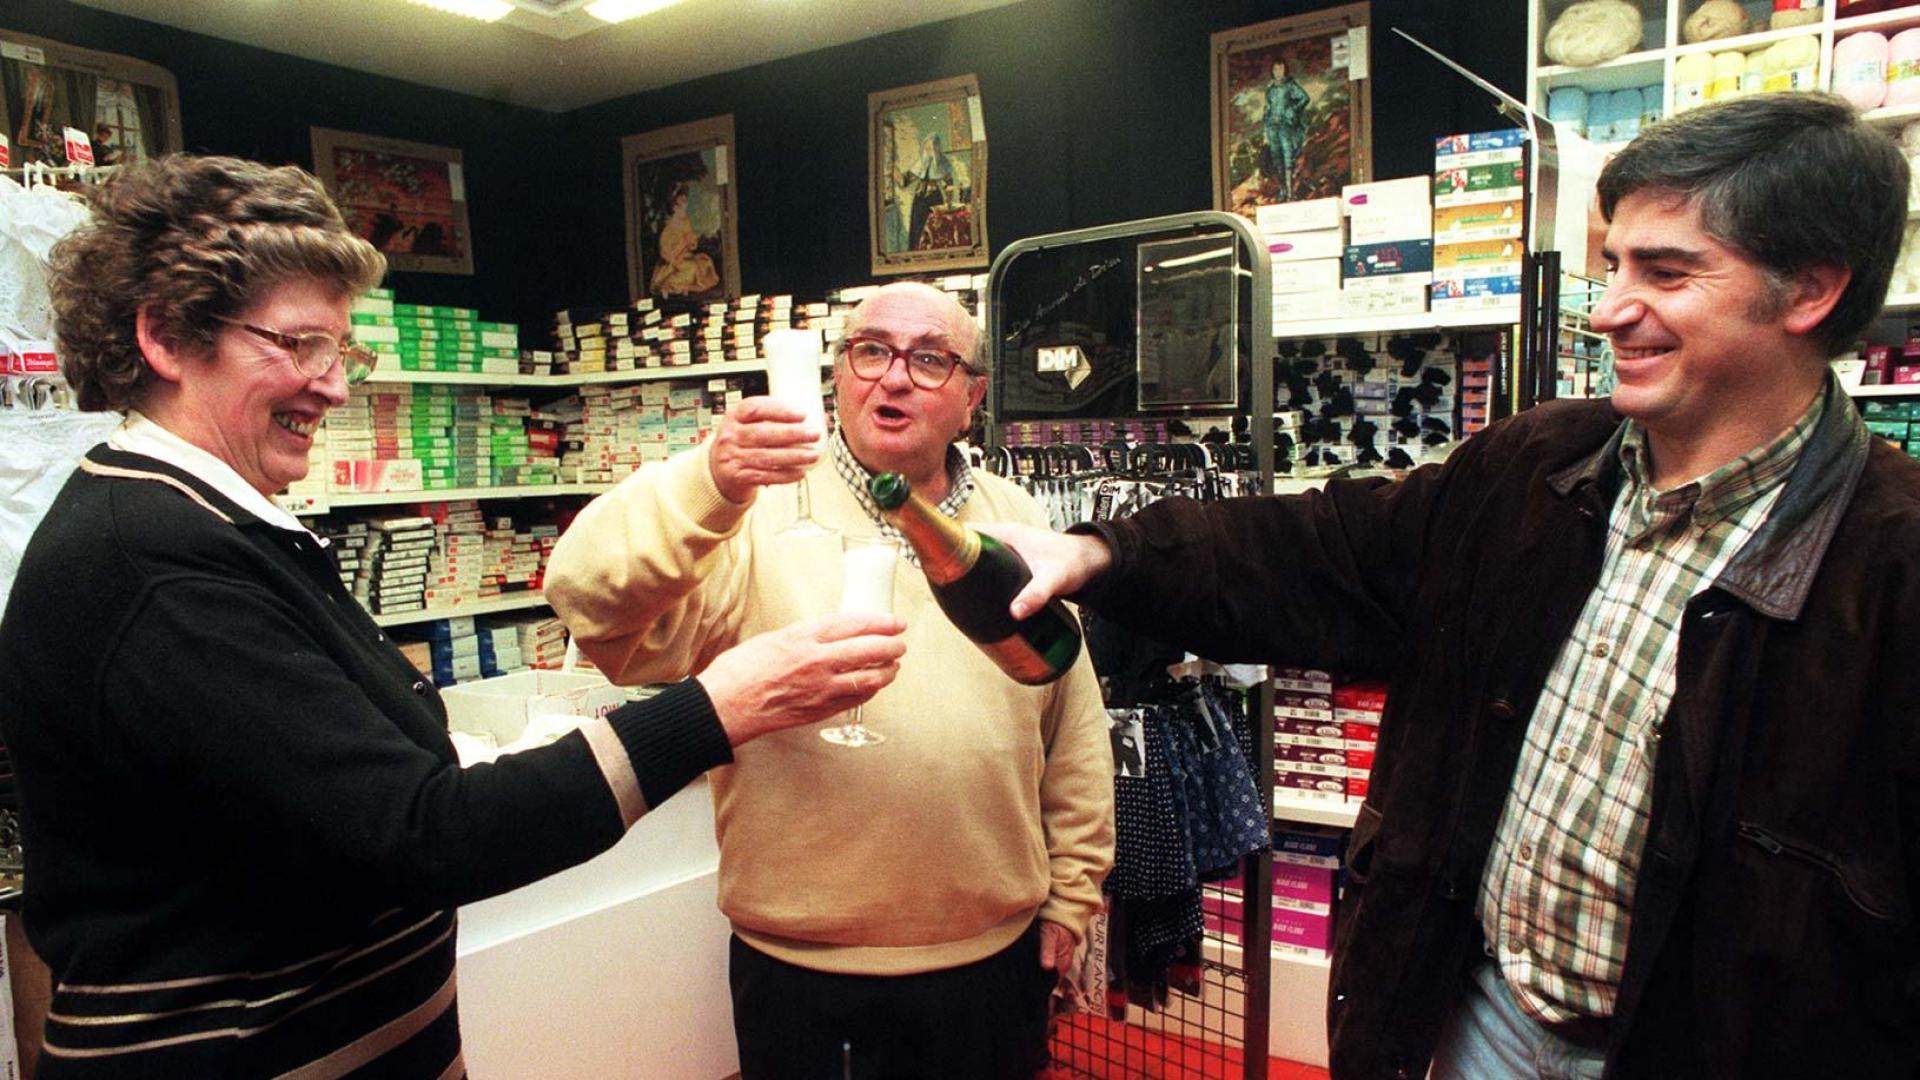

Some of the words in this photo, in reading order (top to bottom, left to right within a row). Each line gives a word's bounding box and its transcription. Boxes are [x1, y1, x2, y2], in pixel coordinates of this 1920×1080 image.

[1038, 347, 1077, 371] DIM
[1101, 484, 1120, 495] DIM
[1095, 913, 1106, 945] PUR
